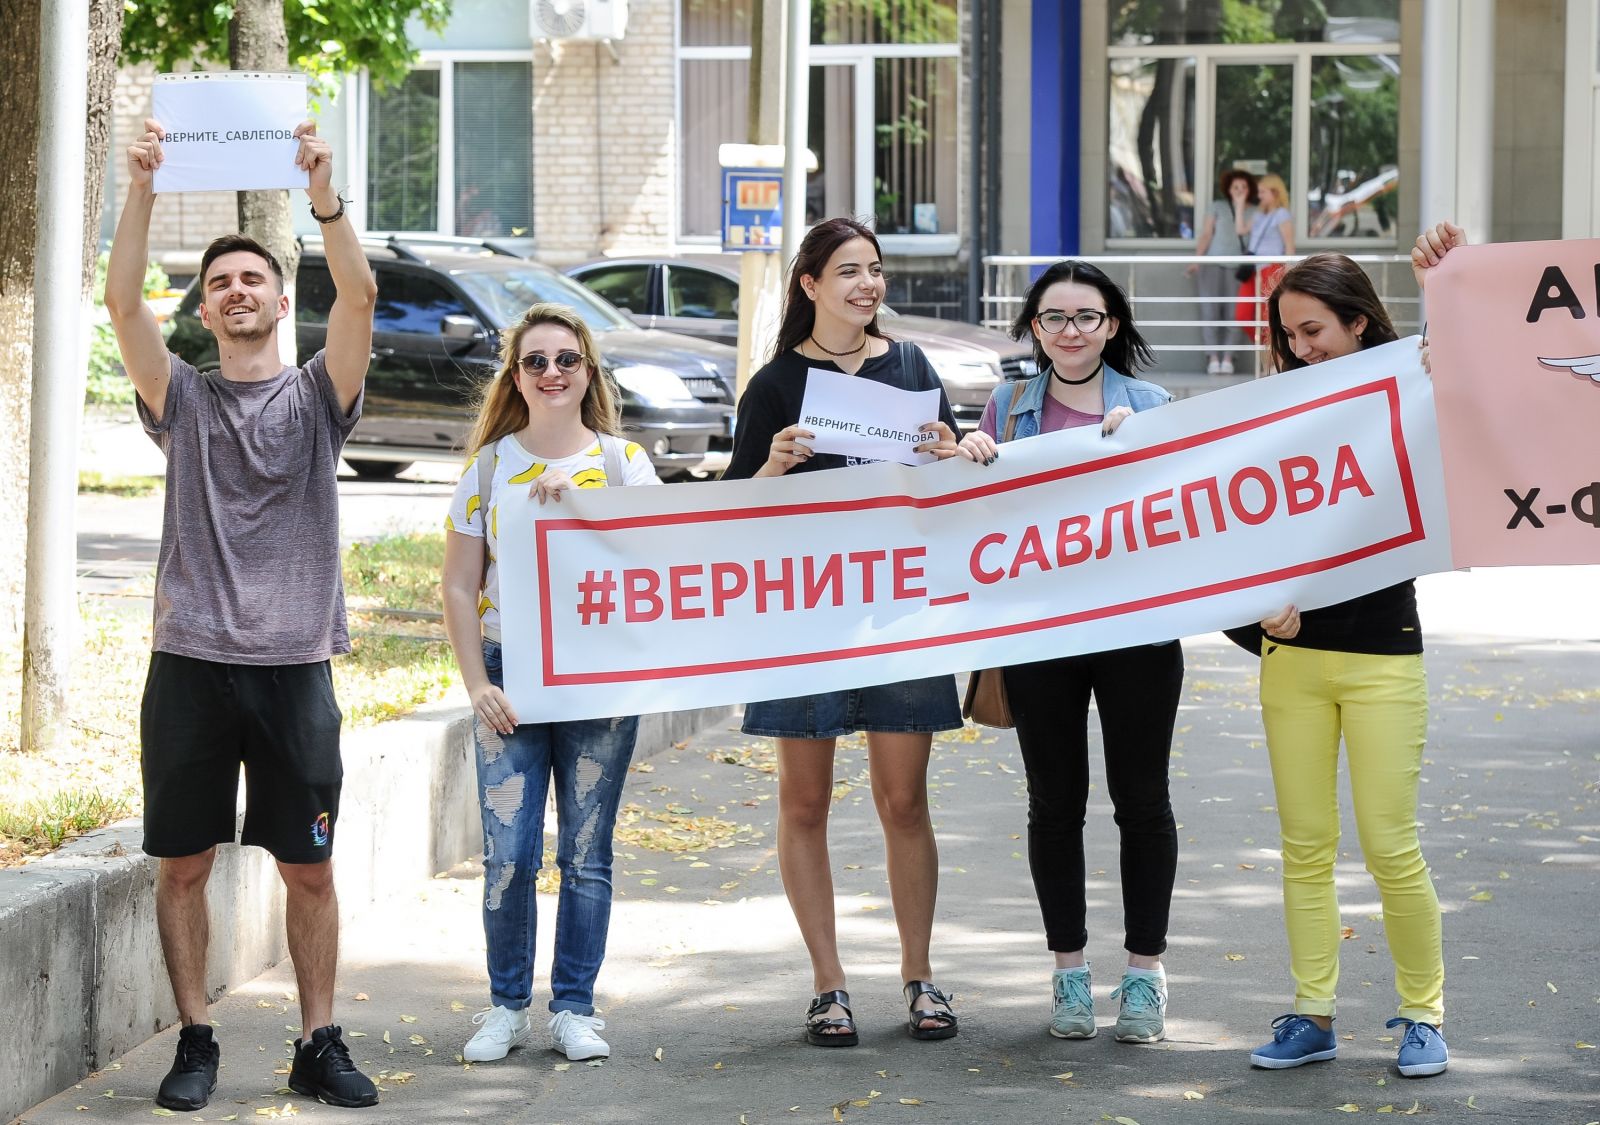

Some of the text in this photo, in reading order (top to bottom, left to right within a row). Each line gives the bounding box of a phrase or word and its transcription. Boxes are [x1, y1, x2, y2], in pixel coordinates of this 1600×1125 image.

[1526, 263, 1600, 323] А
[804, 415, 936, 443] #ВЕРНИТЕ_САВЛЕПОВА
[577, 445, 1374, 625] #ВЕРНИТЕ_САВЛЕПОВА
